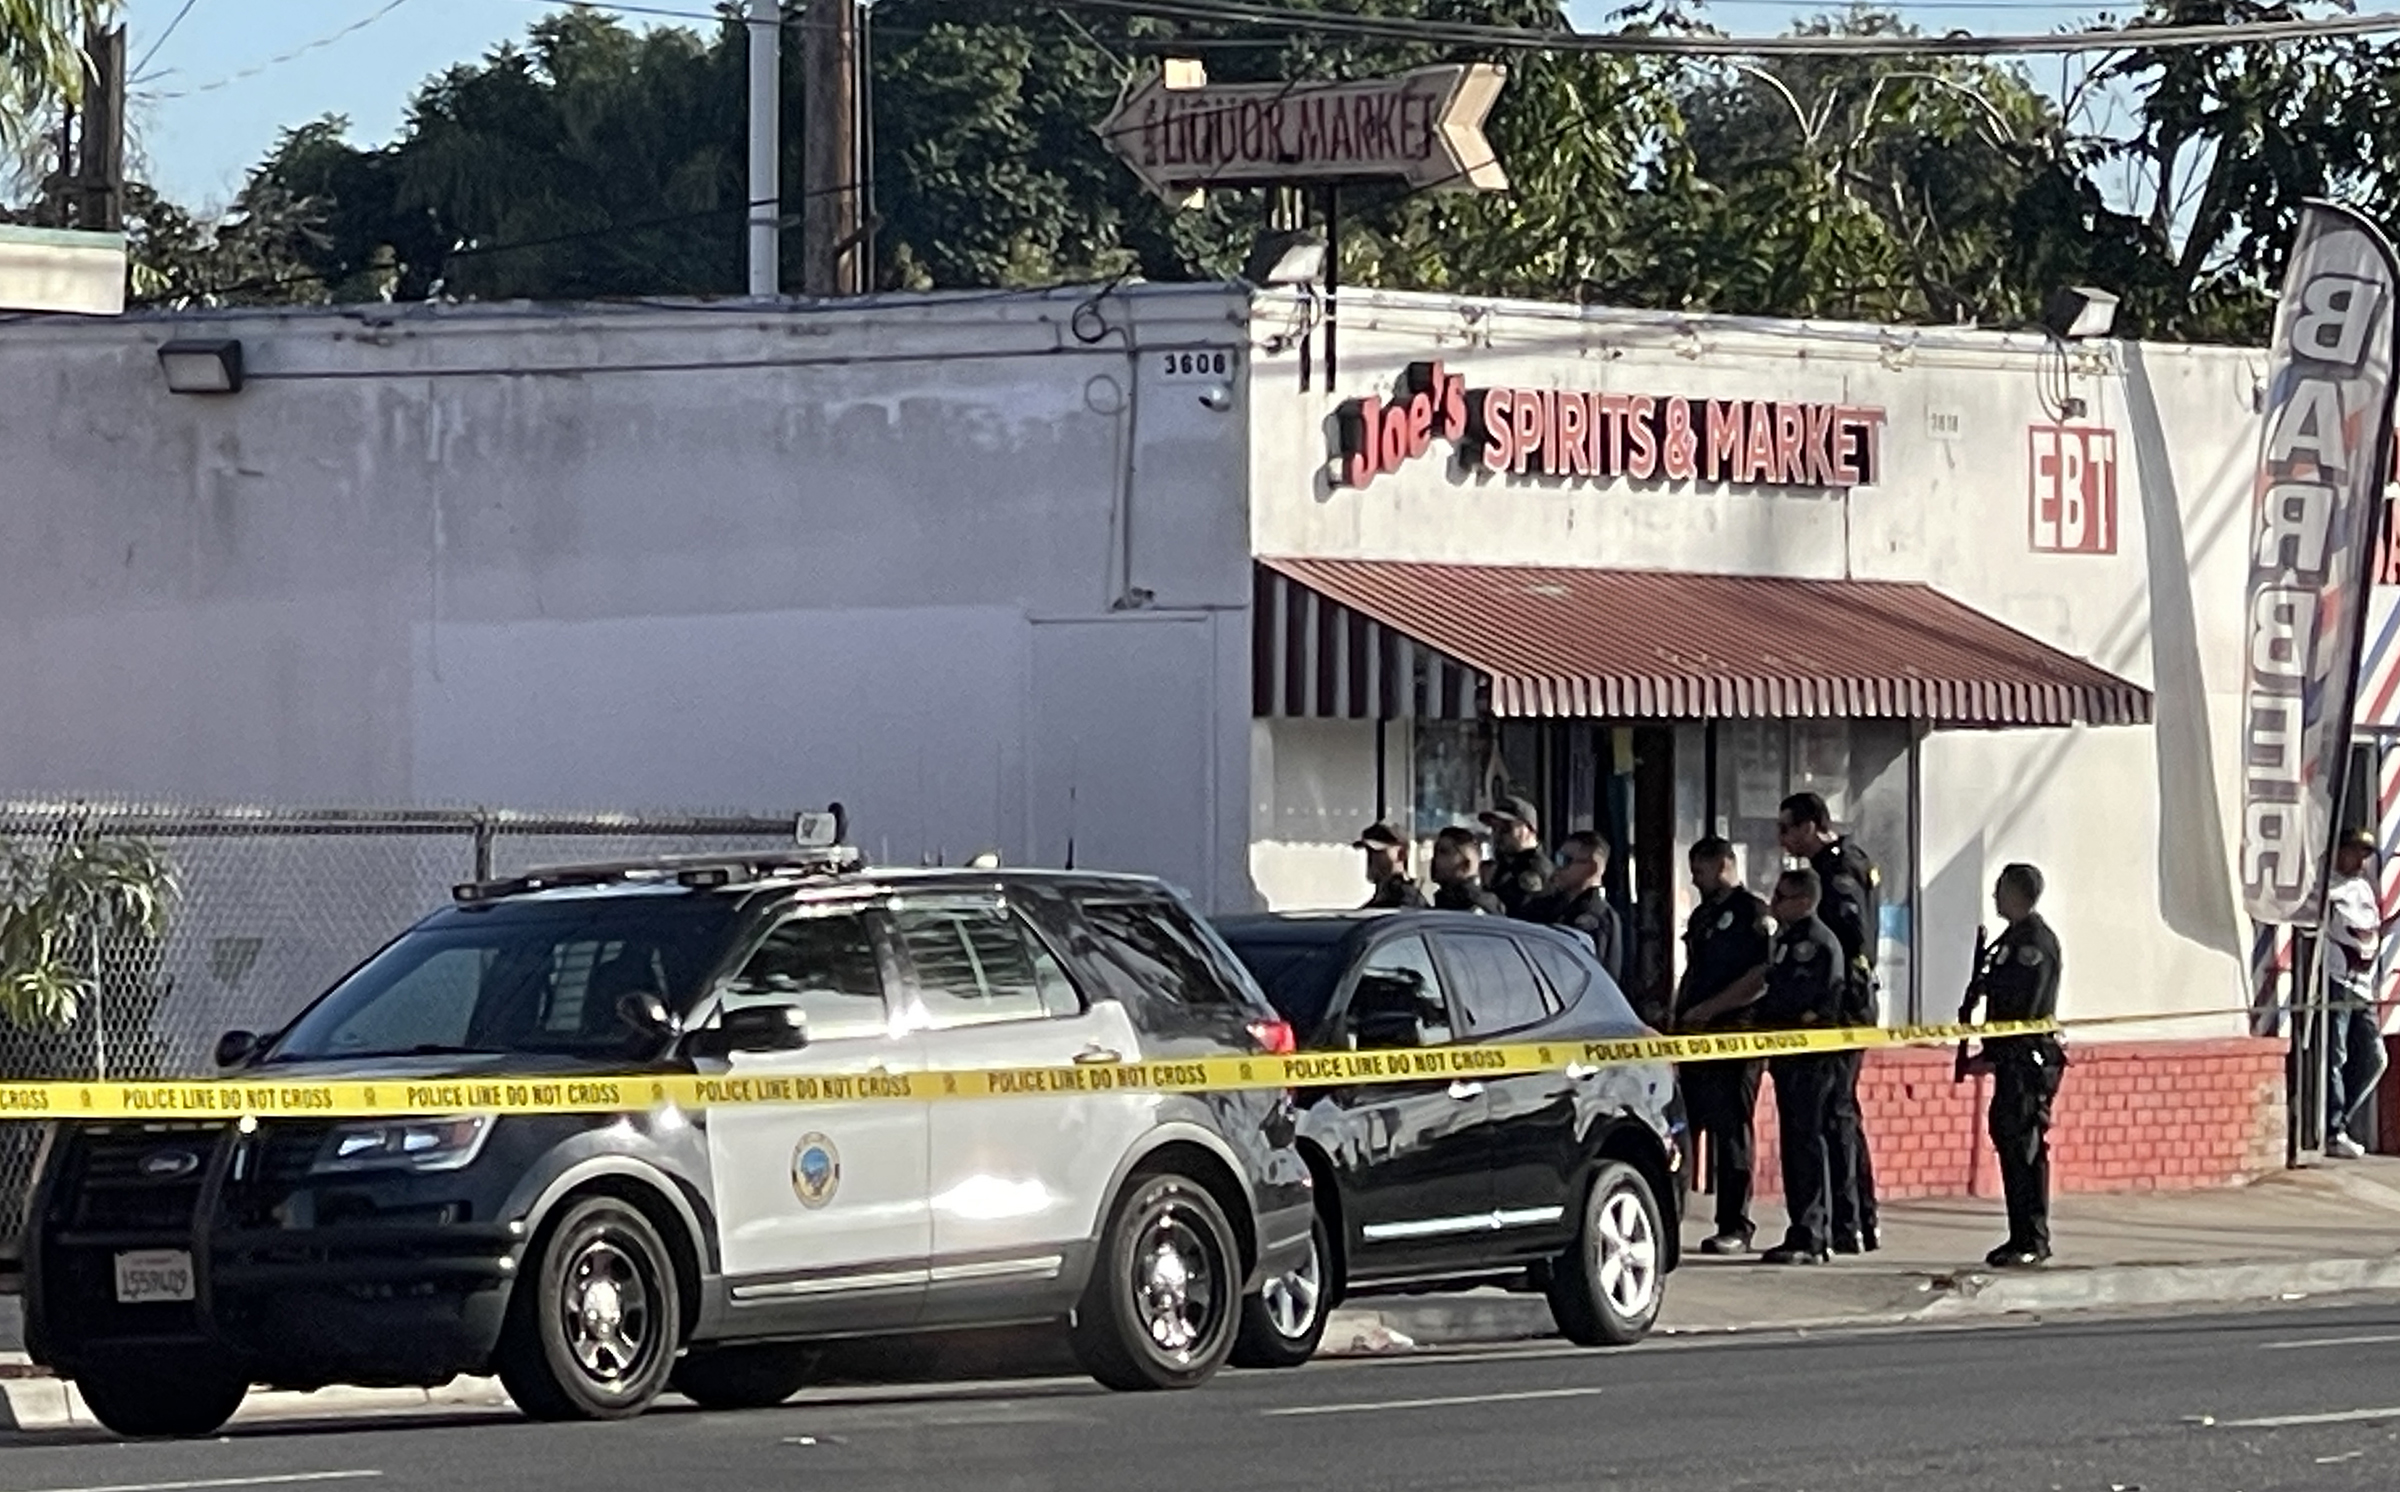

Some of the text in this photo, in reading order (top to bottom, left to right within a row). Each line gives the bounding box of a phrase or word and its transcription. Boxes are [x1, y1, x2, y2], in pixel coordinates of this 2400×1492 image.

[1300, 94, 1437, 162] MARKET
[1351, 358, 1889, 488] Joe's SPIRITS & MARKET
[2031, 430, 2114, 550] EBT
[1584, 1043, 1643, 1061] POLICE
[1647, 1041, 1684, 1057] LINE
[1687, 1038, 1712, 1055] DO
[1715, 1036, 1748, 1052] NOT
[1283, 1050, 1506, 1079] POLICE LINE DO NOT CROSS
[695, 1075, 911, 1101] POLICE LINE DO NOT CROSS
[988, 1064, 1207, 1093] POLICE LINE DO NOT CROSS
[0, 1089, 49, 1110] CROSS
[123, 1089, 332, 1109] POLICE LINE DO NOT CROSS
[407, 1083, 620, 1107] POLICE LINE DO NOT CROSS
